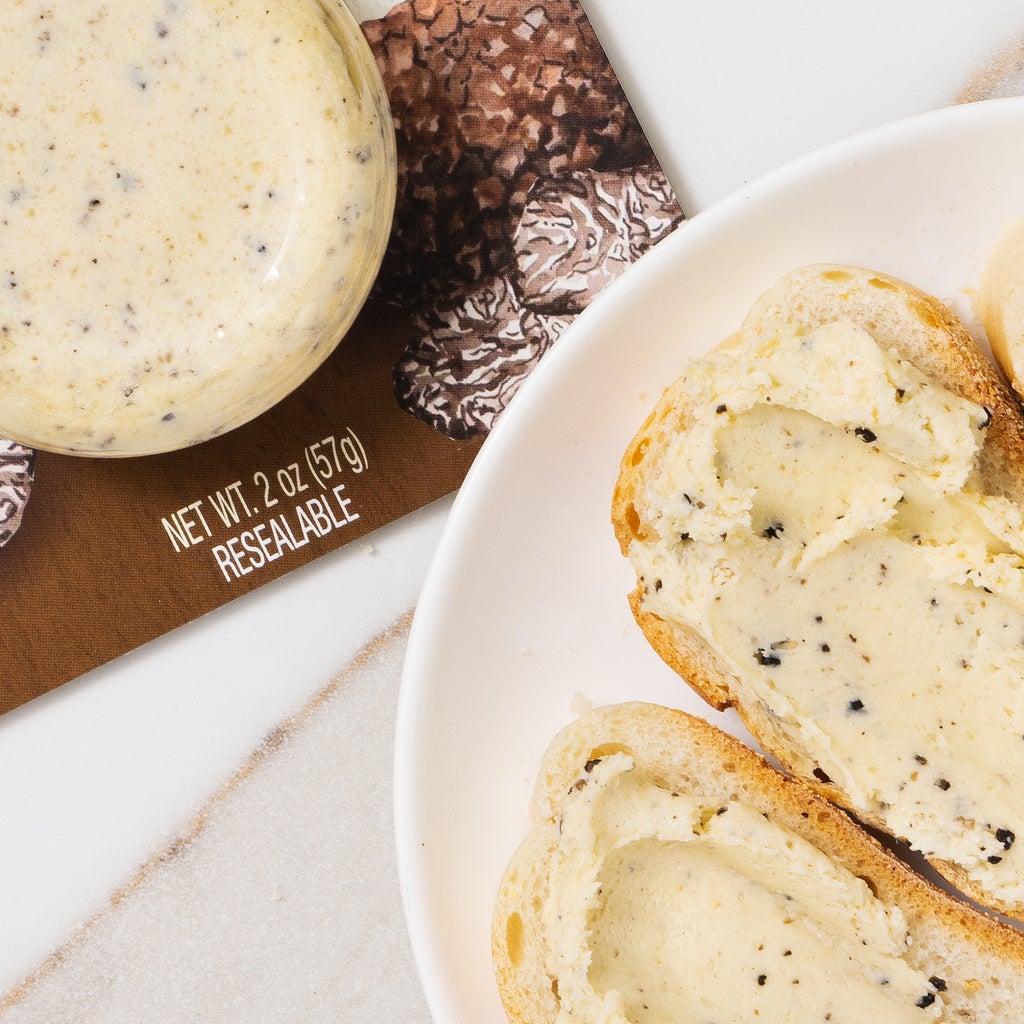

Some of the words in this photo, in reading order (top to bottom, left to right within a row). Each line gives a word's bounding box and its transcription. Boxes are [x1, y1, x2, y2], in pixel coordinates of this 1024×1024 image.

[161, 500, 212, 553] NET
[208, 481, 259, 527] WT.
[253, 471, 278, 508] 2
[277, 462, 309, 497] oz
[304, 427, 369, 490] (57g)
[212, 484, 360, 582] RESEALABLE
